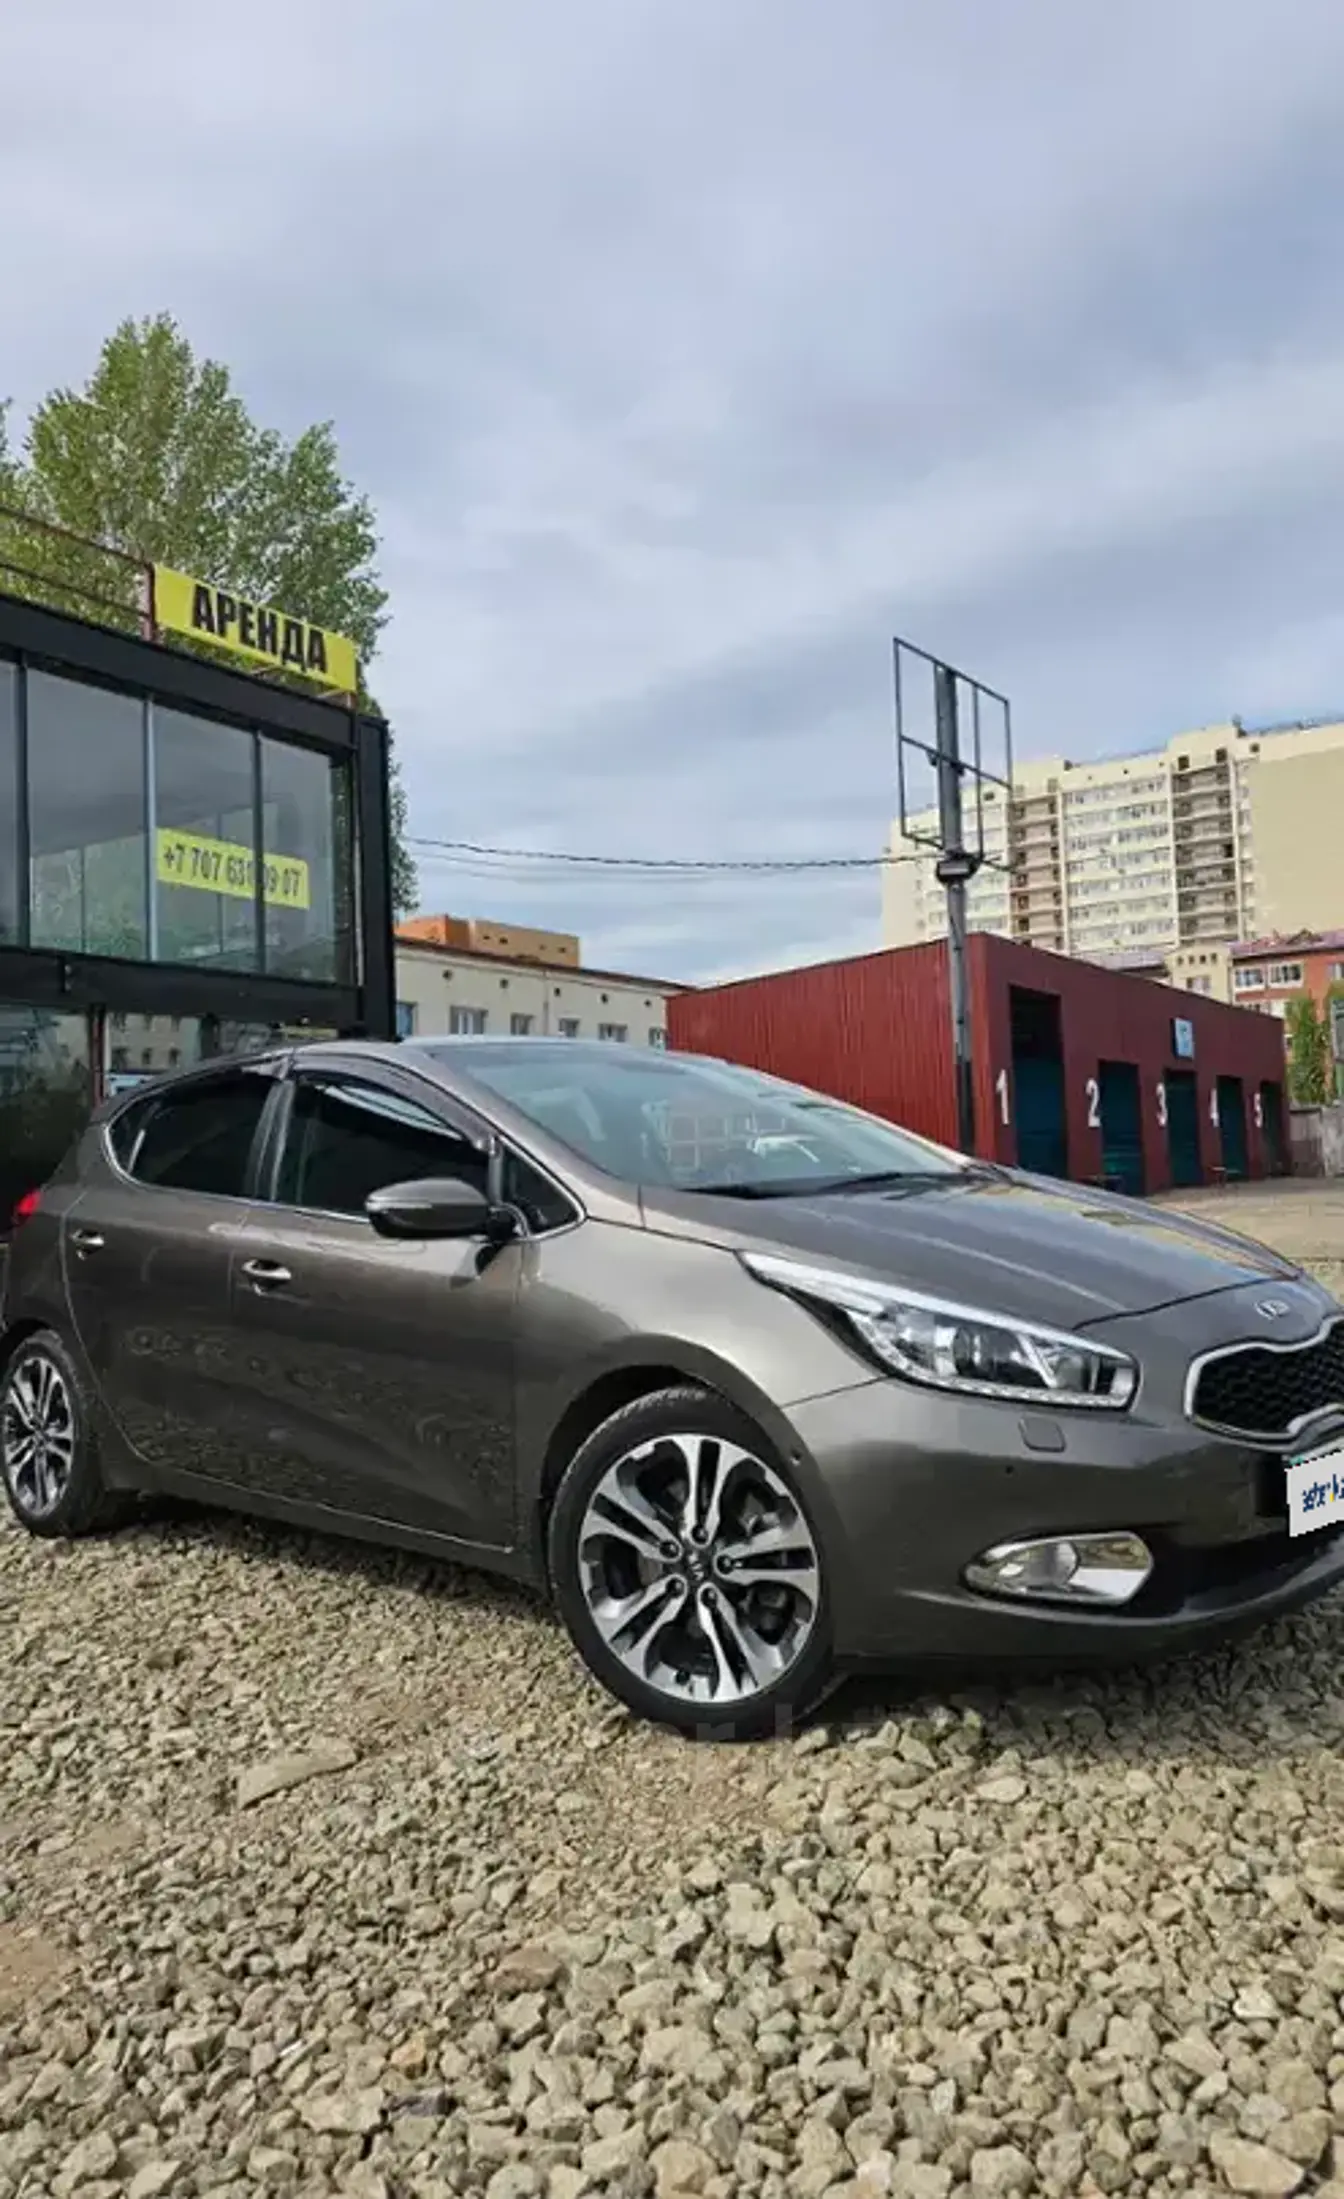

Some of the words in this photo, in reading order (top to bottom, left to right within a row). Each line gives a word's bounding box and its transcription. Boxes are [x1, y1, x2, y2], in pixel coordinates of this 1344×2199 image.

[191, 584, 328, 674] АРЕНДА
[996, 1068, 1010, 1126] 1
[1085, 1078, 1102, 1128] 2
[1156, 1082, 1168, 1128] 3
[1253, 1091, 1264, 1128] 5
